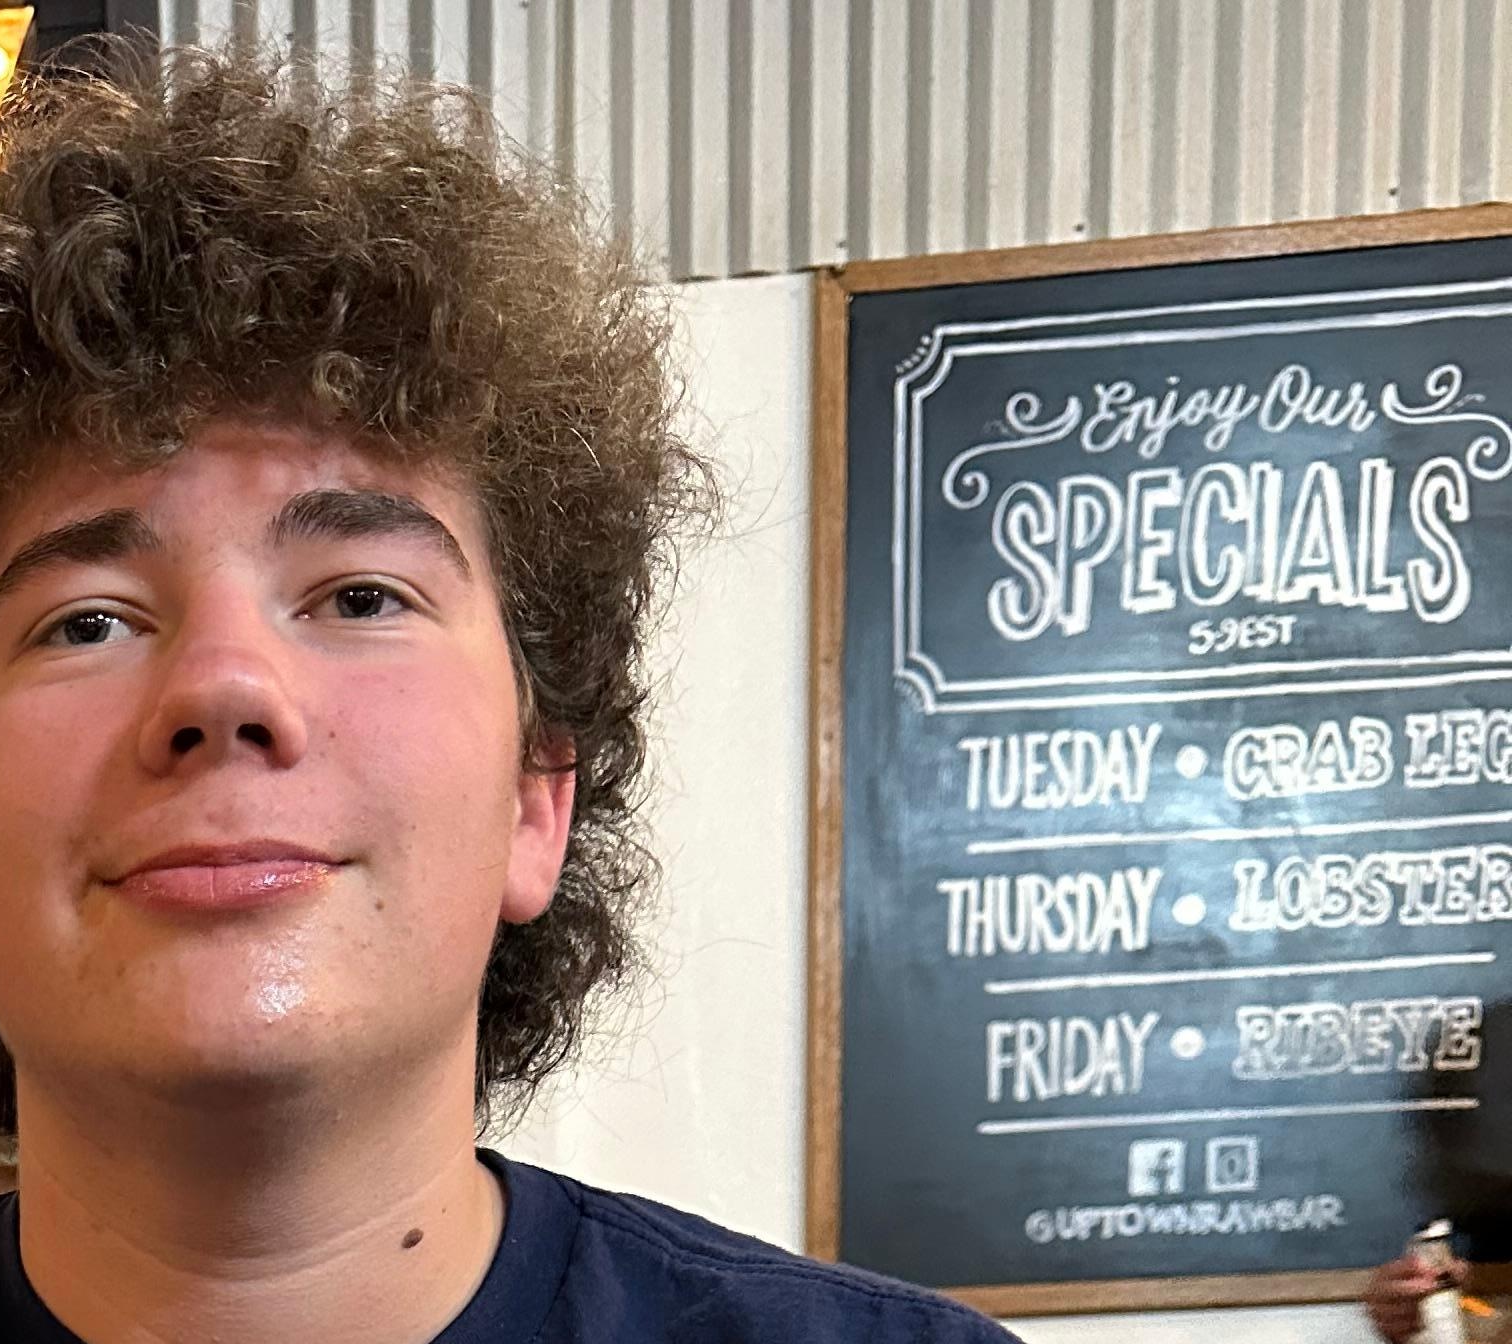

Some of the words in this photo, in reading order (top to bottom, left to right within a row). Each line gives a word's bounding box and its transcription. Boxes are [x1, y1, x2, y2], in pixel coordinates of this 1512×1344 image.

[1080, 375, 1256, 459] Enjoy
[1258, 363, 1378, 432] Our
[988, 455, 1472, 641] SPECIALS
[959, 722, 1163, 811] TUESDAY
[1223, 716, 1394, 800] CRAB
[938, 865, 1163, 957] THURSDAY
[1227, 843, 1512, 932] LOBSTER
[985, 1010, 1160, 1103] FRIDAY
[1232, 996, 1484, 1080] RIBEYE
